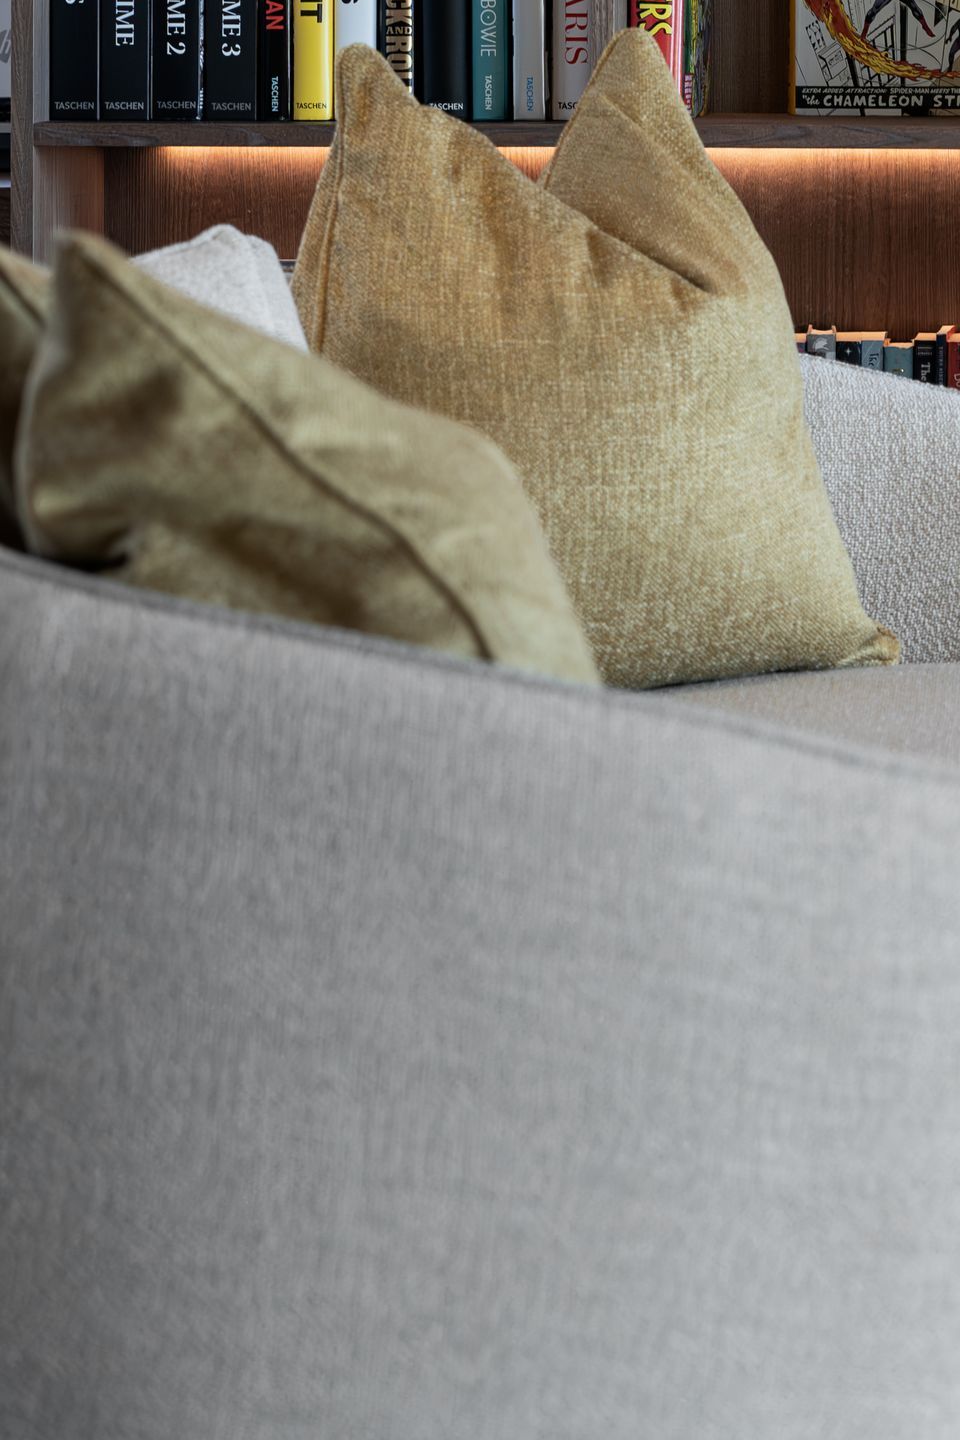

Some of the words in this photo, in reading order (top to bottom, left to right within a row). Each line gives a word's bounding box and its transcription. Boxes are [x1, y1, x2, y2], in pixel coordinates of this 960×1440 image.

[480, 0, 497, 57] BOWIE
[166, 41, 186, 55] 2
[221, 43, 241, 57] 3
[104, 100, 145, 111] TASCHEN
[823, 95, 924, 106] CHAMELEON
